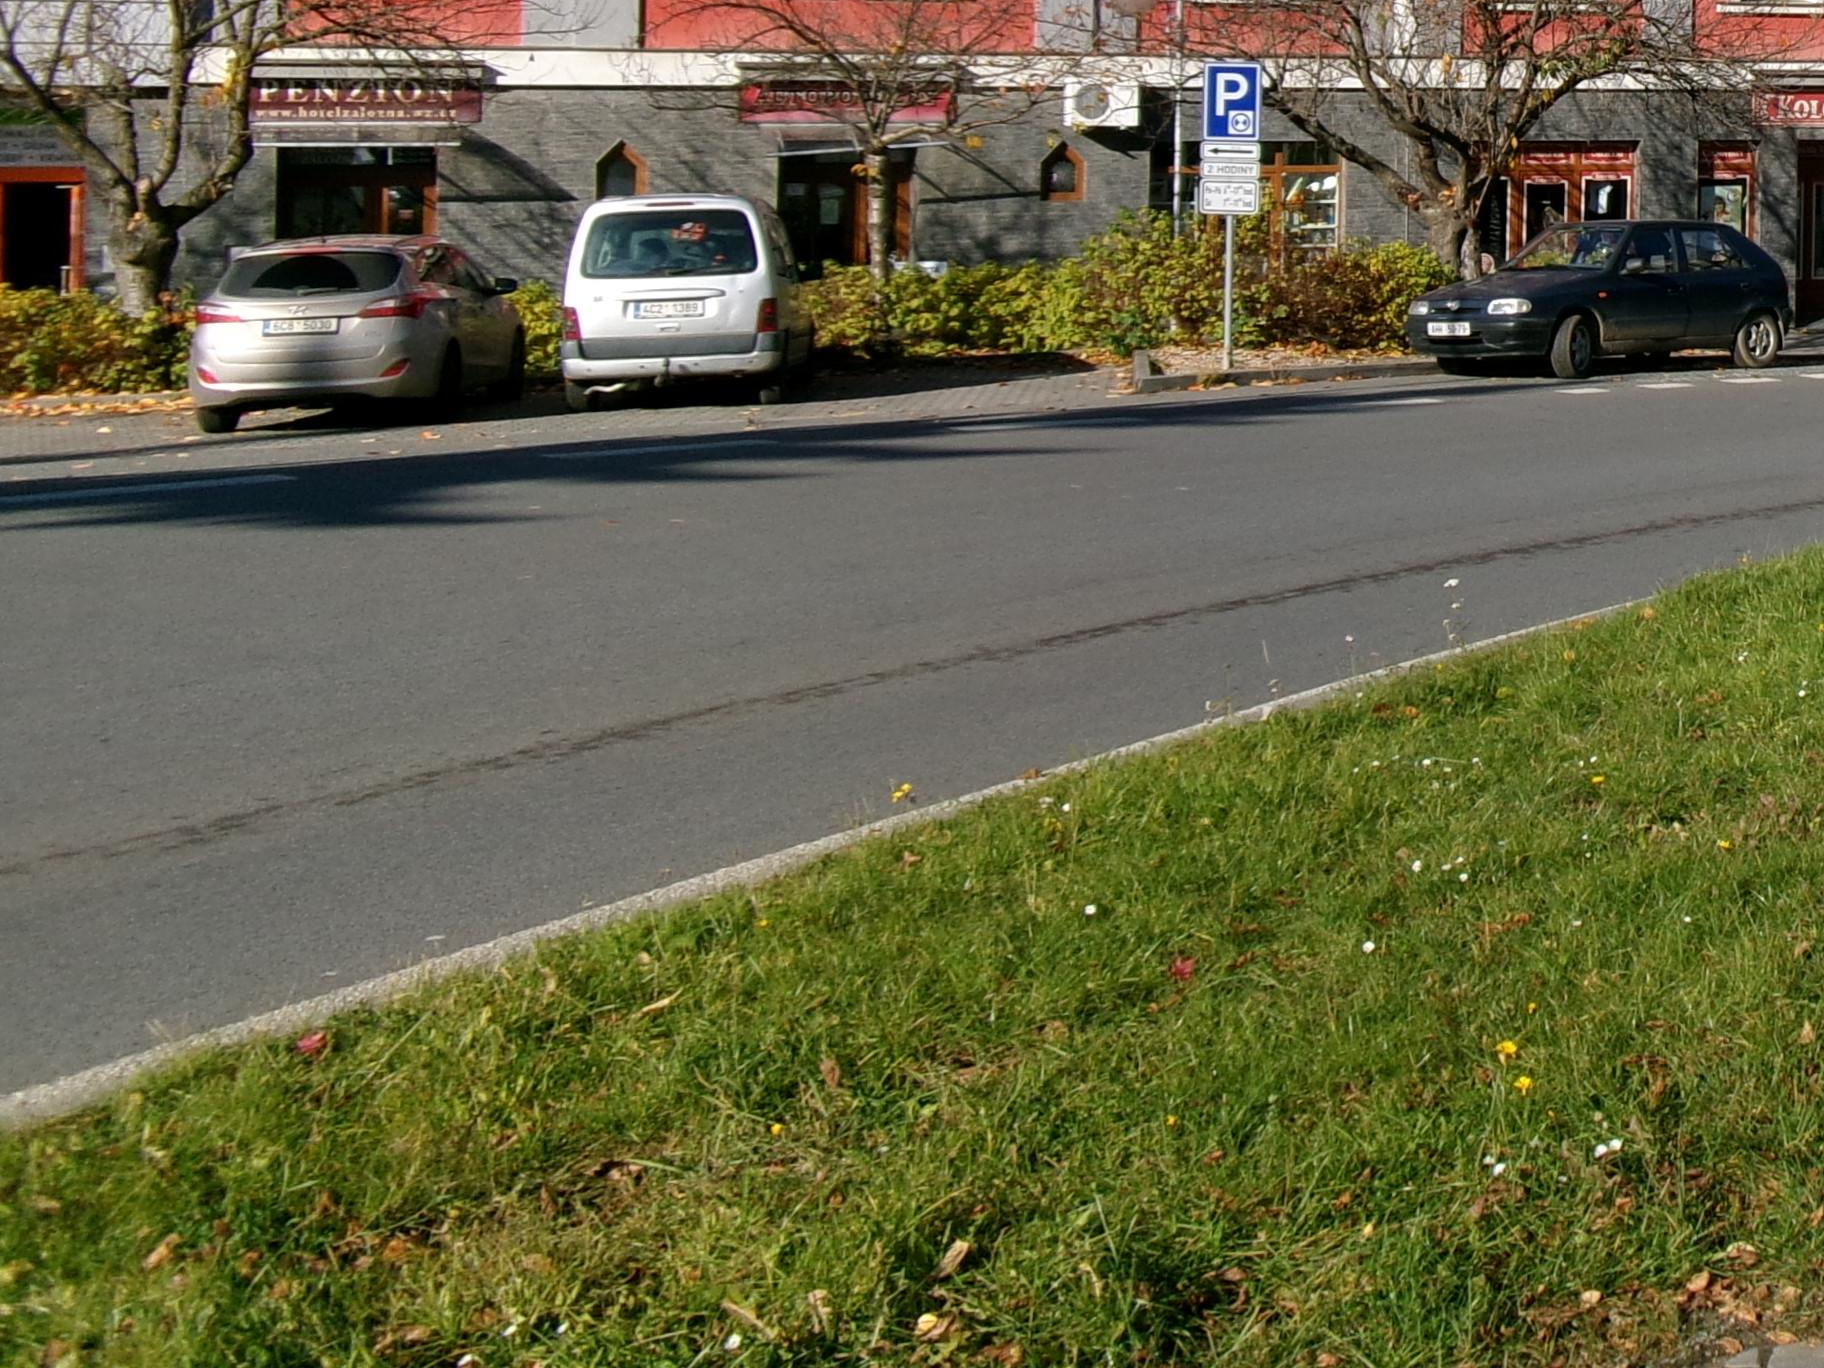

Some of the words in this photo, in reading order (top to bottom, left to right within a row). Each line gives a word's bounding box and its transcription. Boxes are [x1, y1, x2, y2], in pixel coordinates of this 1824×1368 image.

[258, 79, 455, 103] PENZION
[1215, 72, 1249, 117] P
[1216, 165, 1254, 175] HODINY
